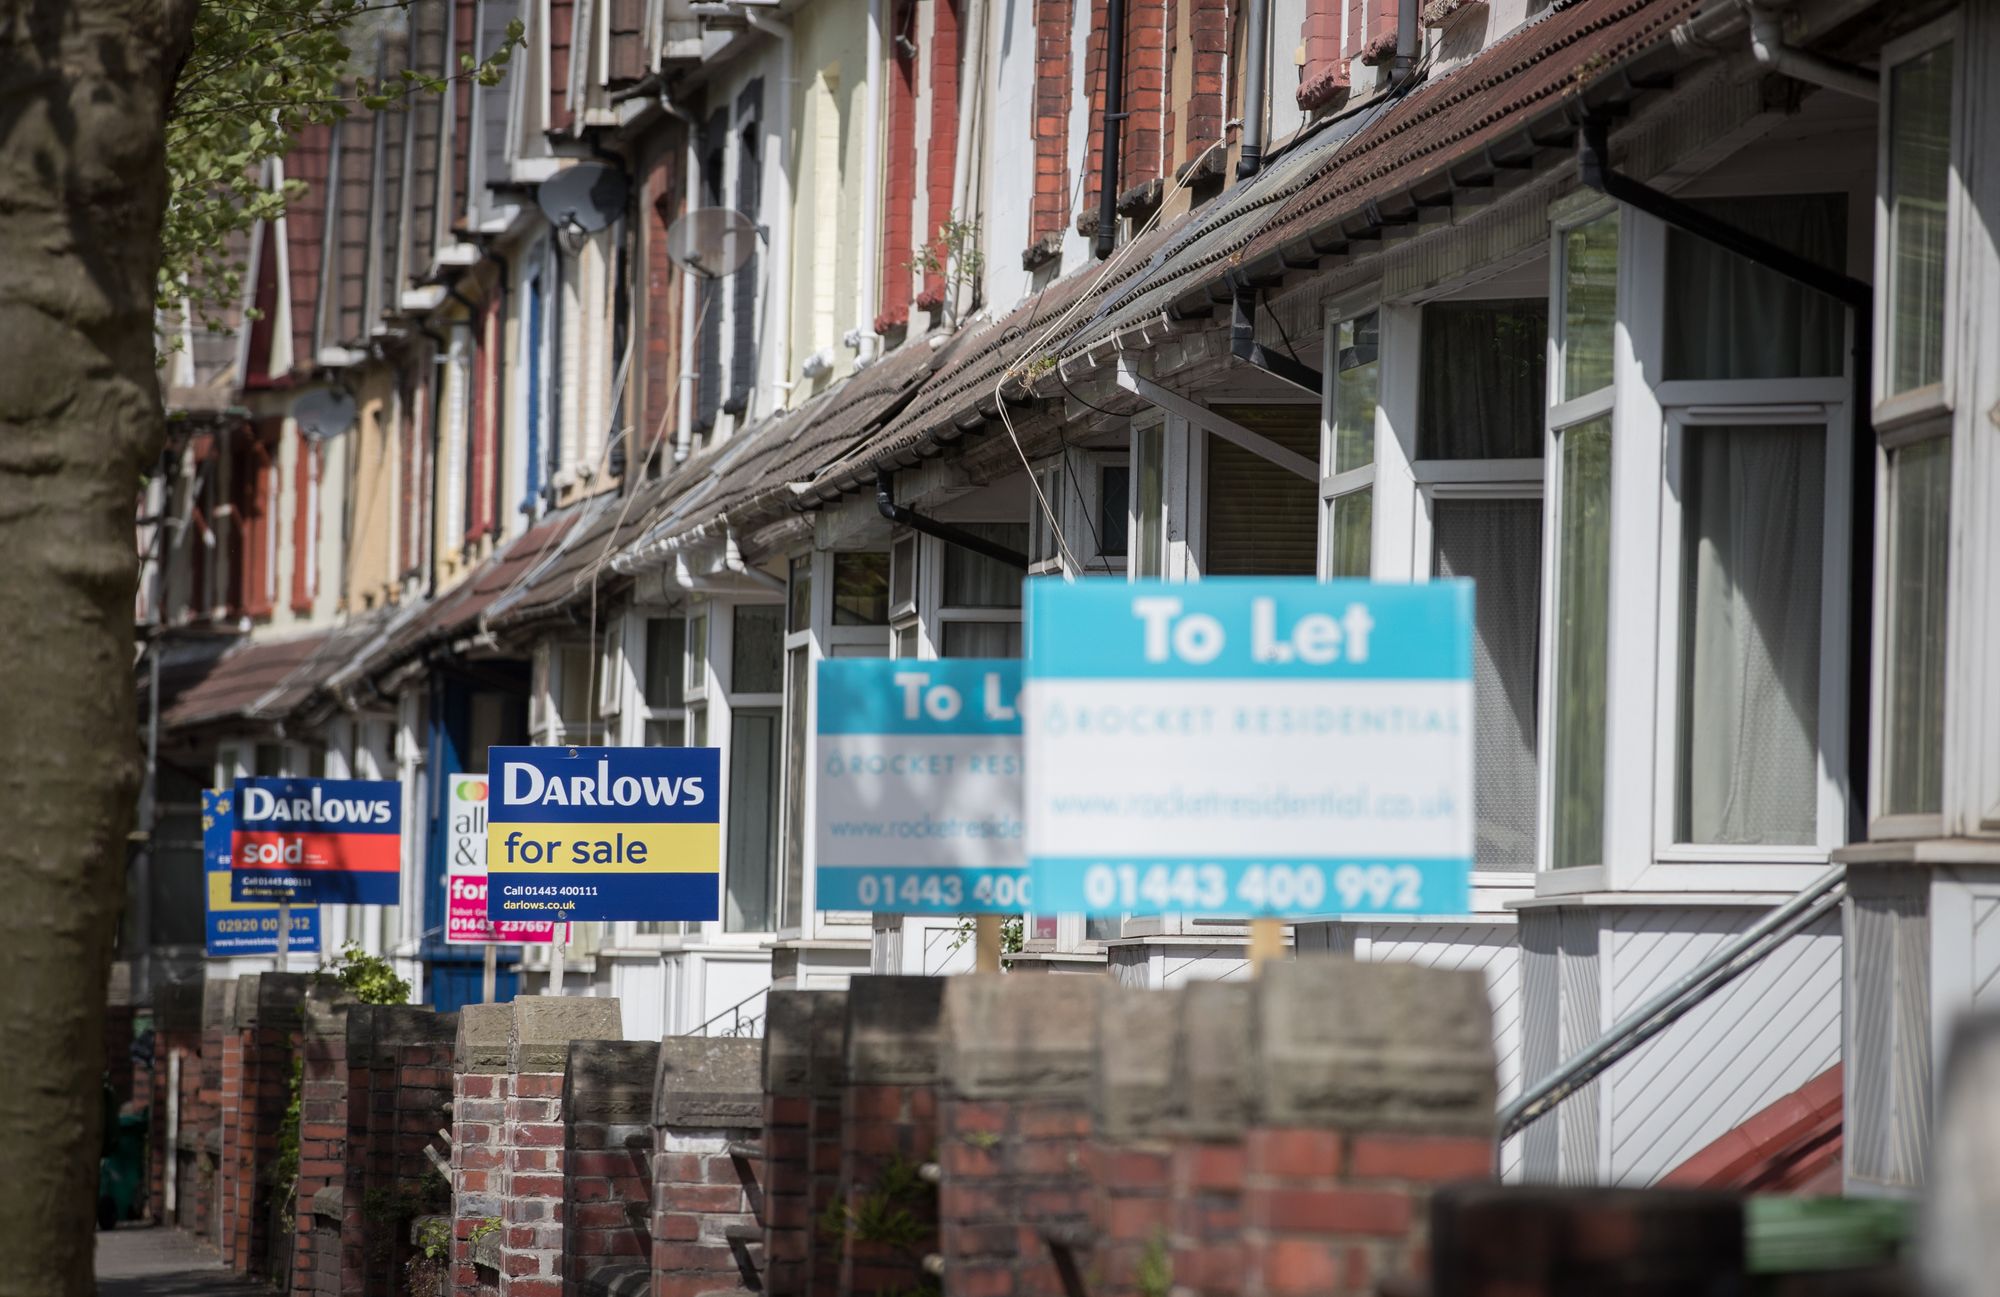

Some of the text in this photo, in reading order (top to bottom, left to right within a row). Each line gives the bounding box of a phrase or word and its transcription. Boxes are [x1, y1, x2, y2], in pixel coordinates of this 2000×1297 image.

[1132, 597, 1375, 665] To Let
[894, 672, 962, 721] To
[1074, 705, 1461, 736] ROCKET RESIDENTIAL
[851, 754, 956, 775] ROCKET
[455, 806, 488, 834] all
[243, 838, 302, 864] sold
[455, 837, 477, 866] &
[504, 832, 562, 864] for
[572, 833, 648, 864] sale
[503, 886, 598, 896] Call 01443 400111
[858, 875, 963, 906] 01443
[1083, 864, 1423, 909] 01443 400 992
[503, 900, 576, 910] darlows.co.uk
[501, 920, 552, 933] 237667
